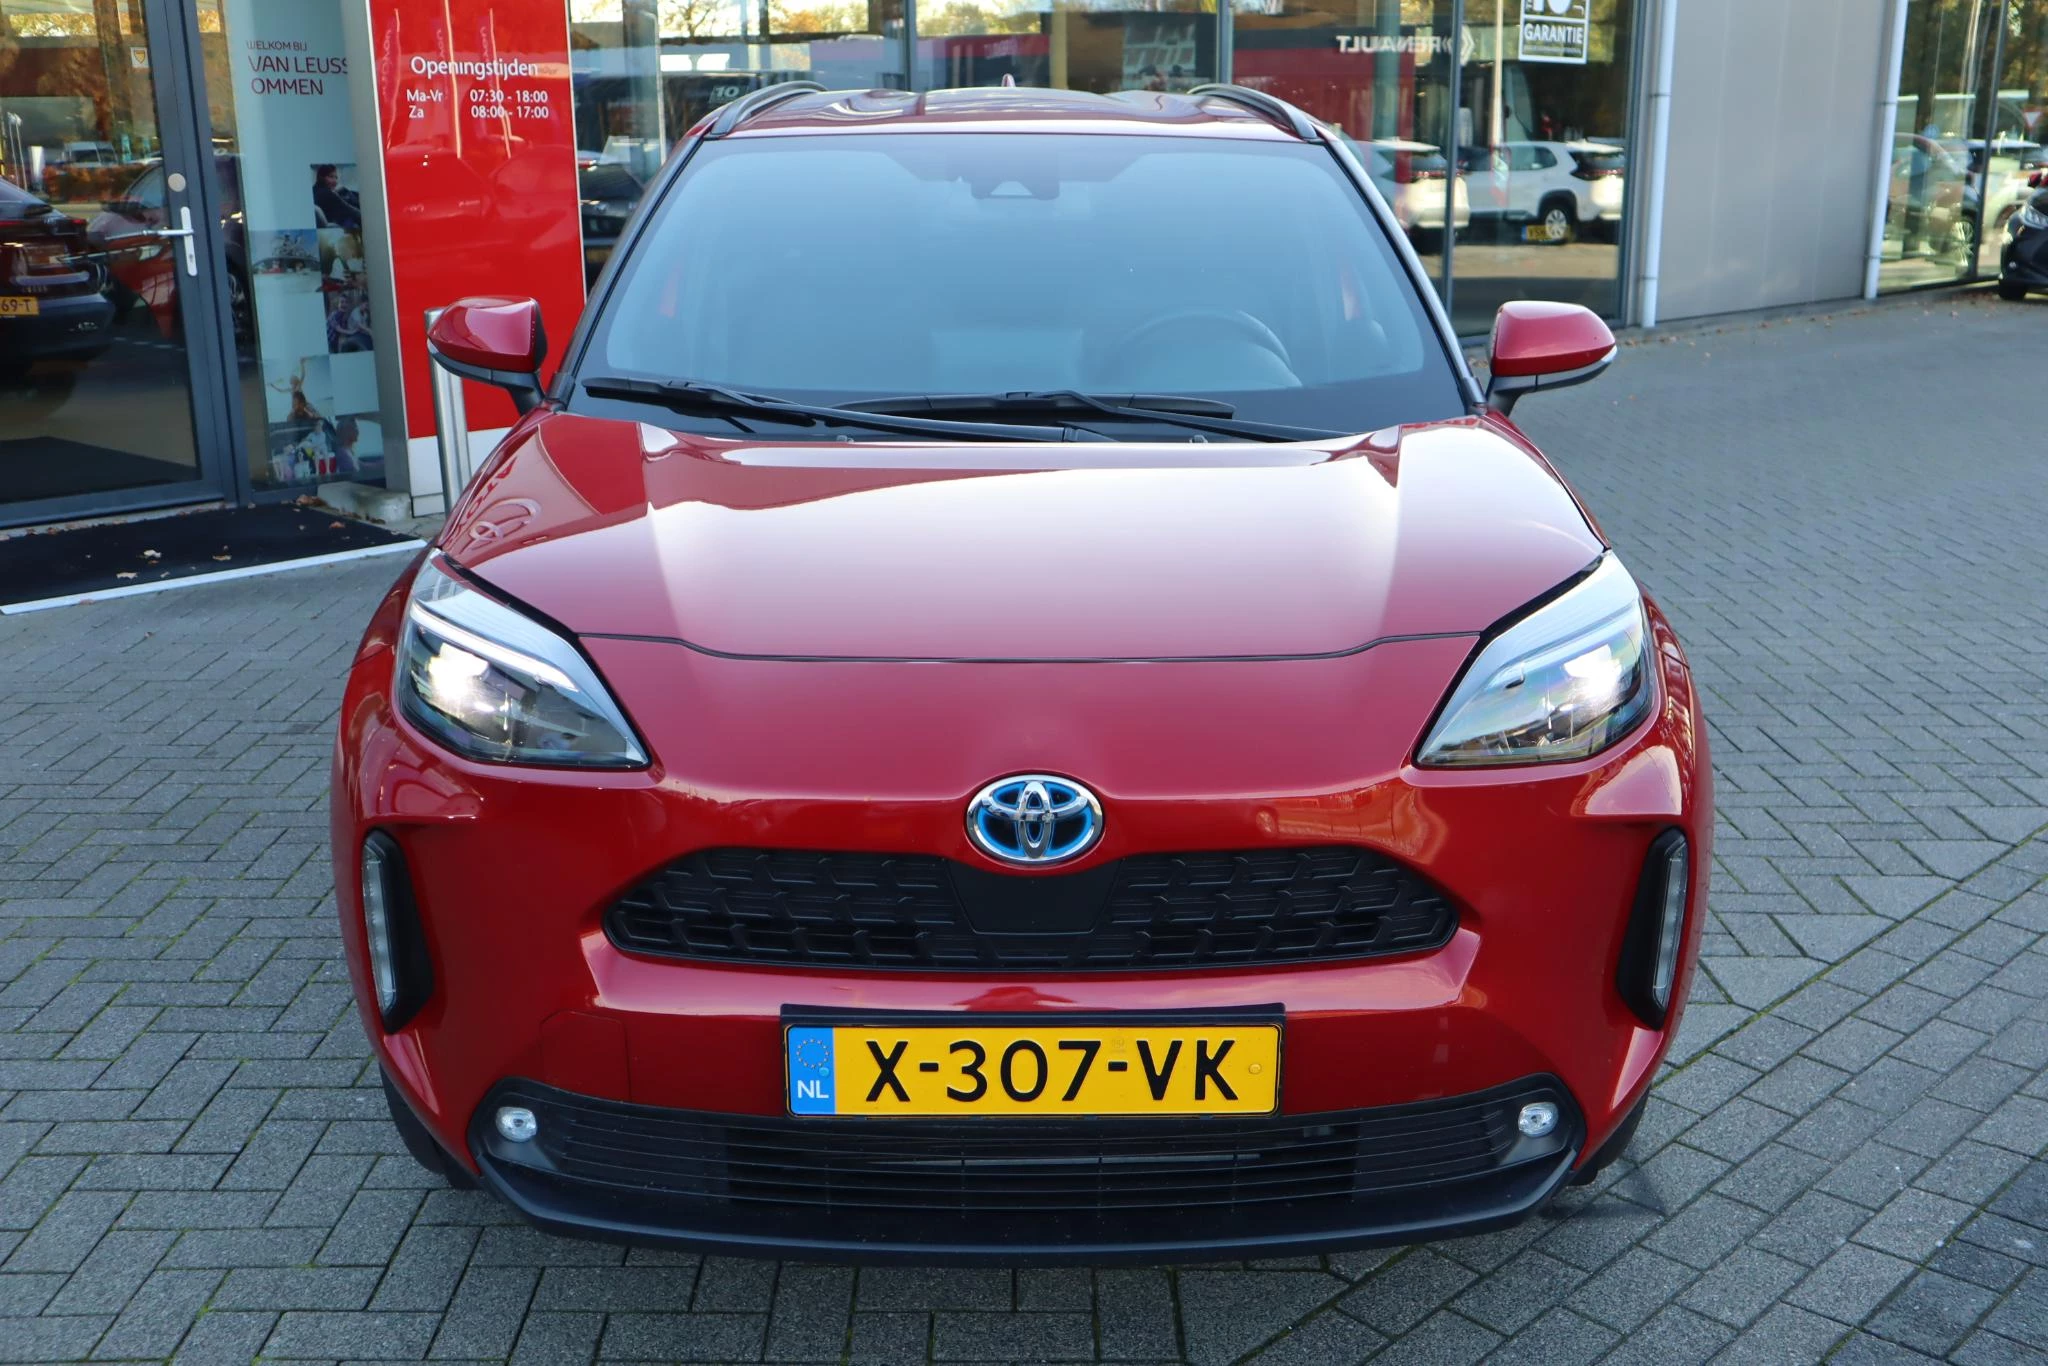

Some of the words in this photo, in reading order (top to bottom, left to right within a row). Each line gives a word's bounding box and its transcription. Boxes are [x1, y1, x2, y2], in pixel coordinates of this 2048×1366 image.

[1524, 23, 1584, 45] GARANTIE
[246, 40, 291, 51] WELKOM
[293, 41, 307, 52] BIJ
[248, 55, 290, 72] VAN
[410, 55, 539, 81] Openingstijden
[251, 78, 324, 95] OMMEN
[714, 86, 740, 98] 10
[406, 89, 443, 102] Ma-Vr
[469, 90, 504, 102] 07:30
[516, 90, 548, 102] 18:00
[409, 105, 425, 118] Za
[471, 106, 505, 118] 08:00
[516, 106, 549, 118] 17:00
[864, 1039, 1239, 1102] X-307-VK
[796, 1079, 829, 1099] NL
